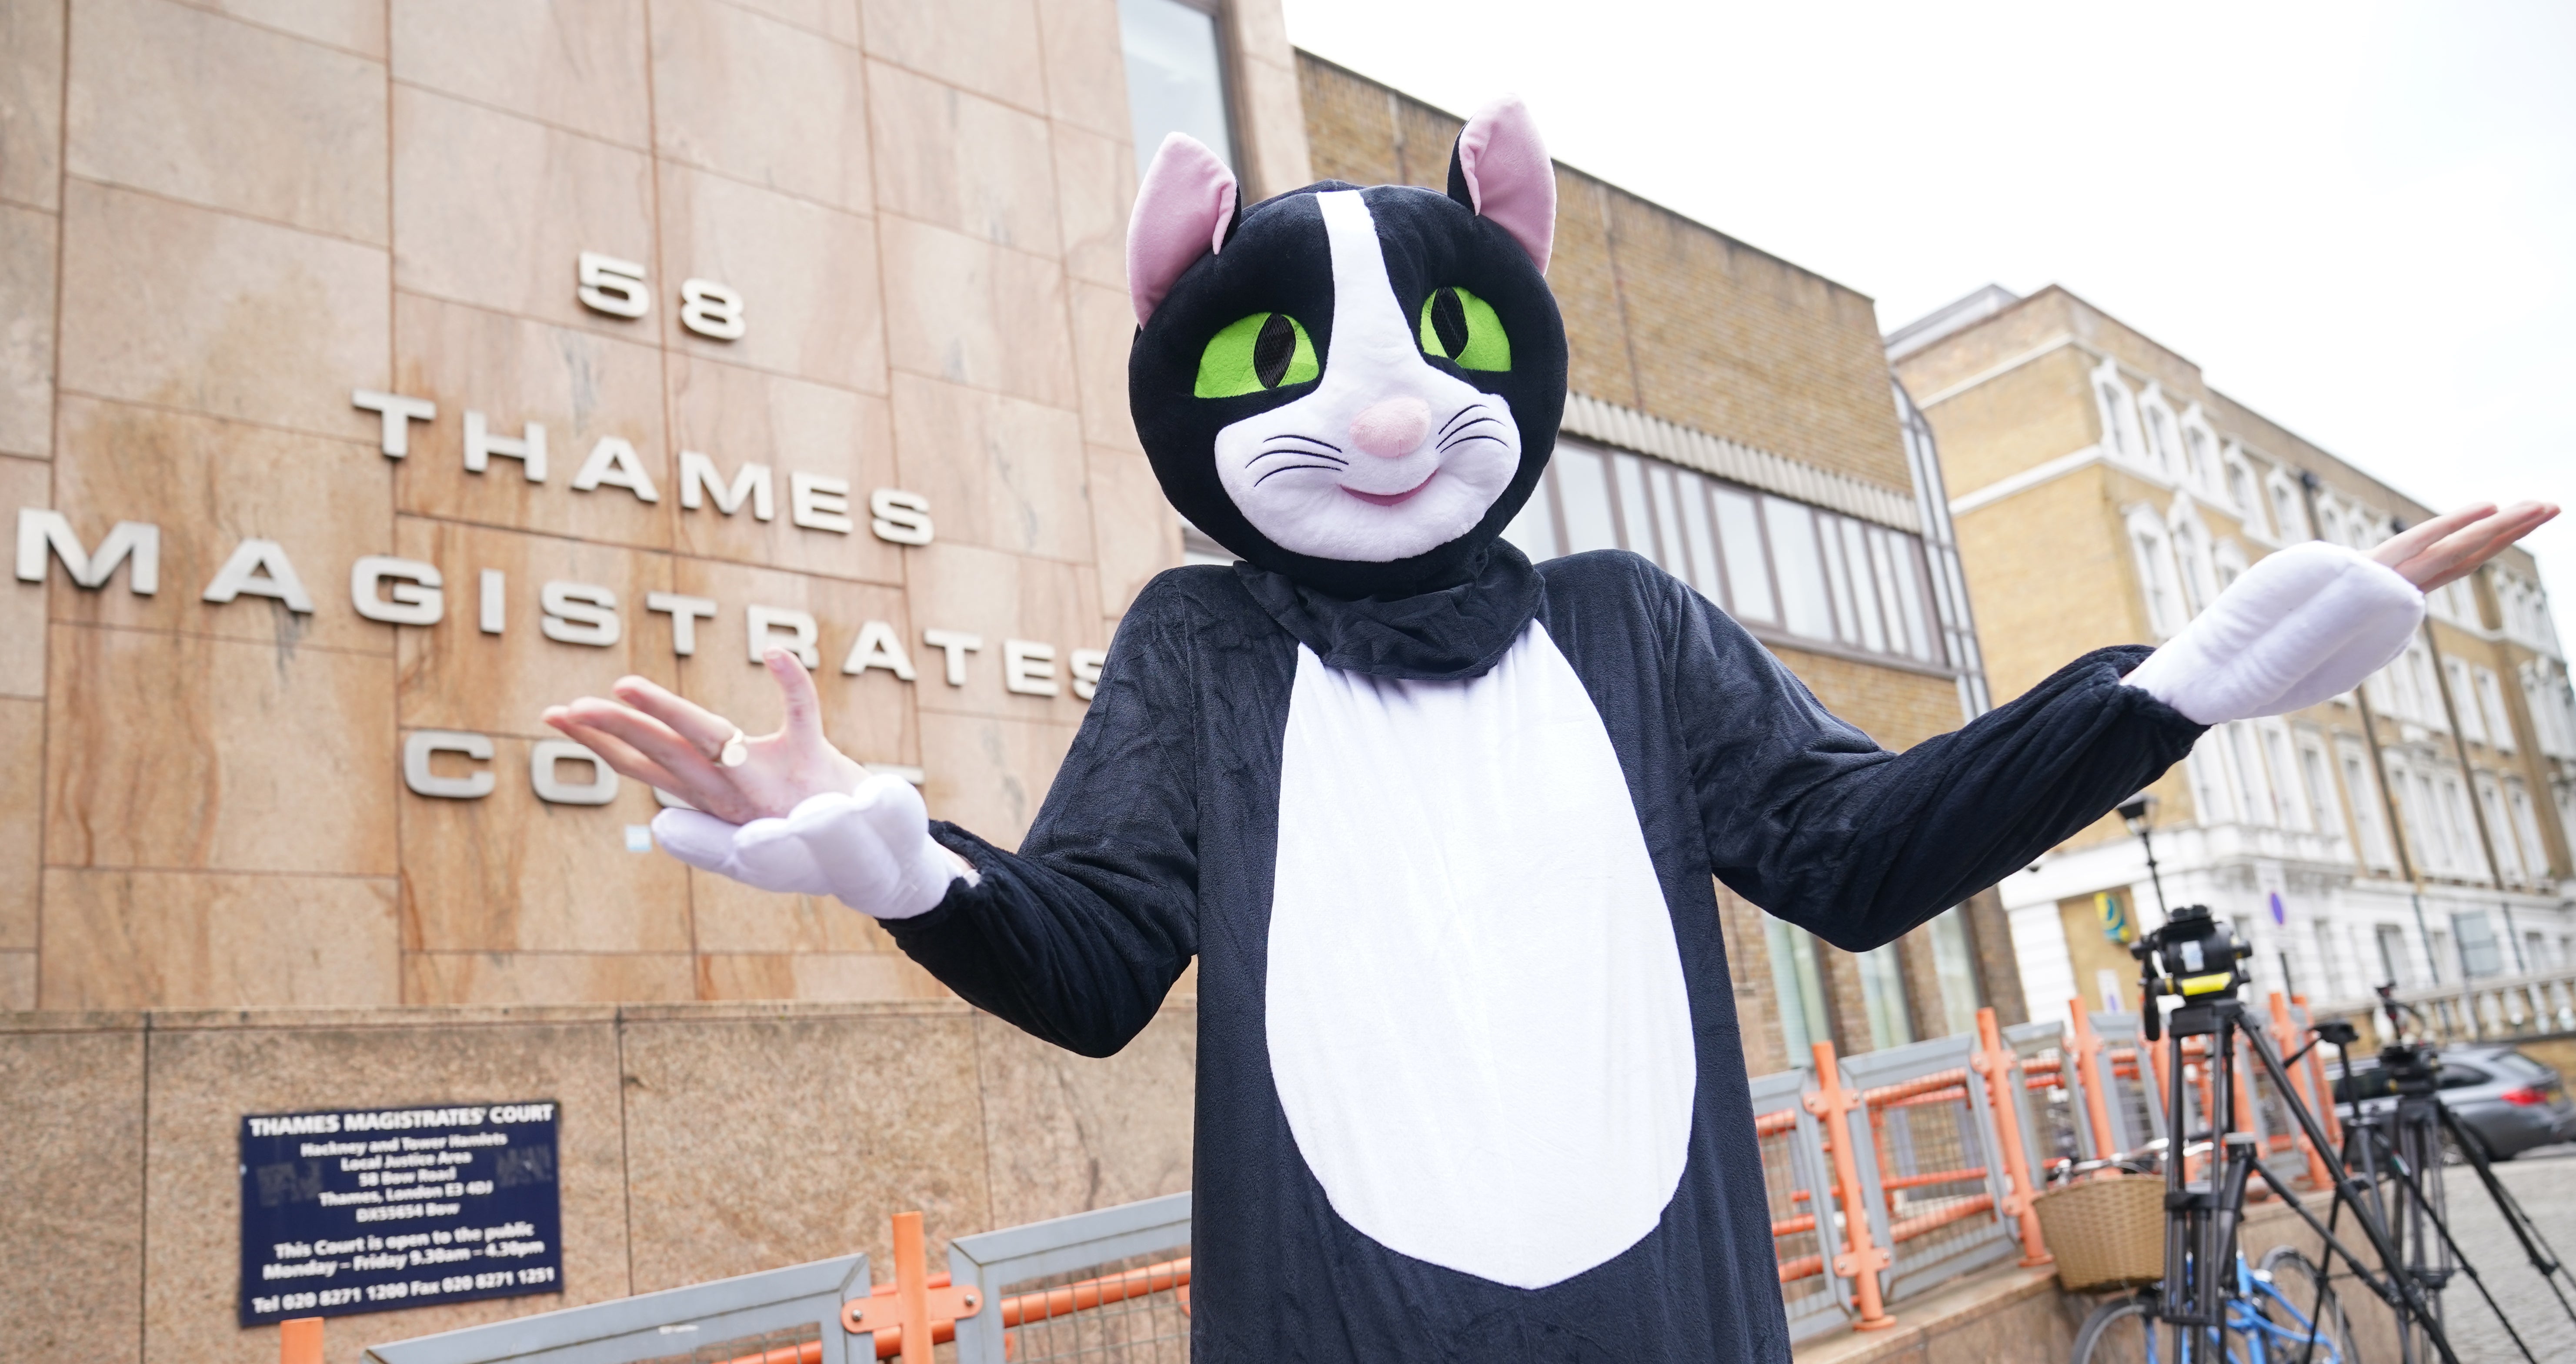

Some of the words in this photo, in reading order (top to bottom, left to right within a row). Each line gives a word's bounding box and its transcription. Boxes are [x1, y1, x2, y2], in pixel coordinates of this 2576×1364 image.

[578, 251, 746, 341] 58
[352, 389, 934, 546] THAMES
[248, 1114, 340, 1137] THAMES
[344, 1107, 487, 1131] MAGISTRATES'
[489, 1104, 554, 1124] COURT
[300, 1140, 368, 1157] Hackney
[368, 1137, 400, 1153] and
[400, 1137, 447, 1151] Tower
[448, 1132, 508, 1148] Hamlets
[340, 1154, 383, 1171] Local
[384, 1152, 436, 1169] Justice
[437, 1151, 473, 1165] Area
[358, 1172, 380, 1187] 58
[380, 1171, 416, 1185] Bow
[417, 1166, 457, 1183] Road
[318, 1191, 384, 1207] Thames,
[385, 1184, 444, 1201] London
[444, 1182, 465, 1197] E3
[466, 1180, 494, 1195] 4DJ
[425, 1202, 461, 1217] Bow
[274, 1241, 313, 1260] This
[314, 1237, 366, 1256] Court
[367, 1234, 384, 1250] is
[385, 1233, 430, 1251] open
[431, 1230, 453, 1244] to
[453, 1227, 483, 1243] the
[484, 1221, 535, 1243] public
[262, 1259, 338, 1280] Monday
[353, 1252, 408, 1271] Friday
[409, 1247, 471, 1266] 9.30am
[484, 1240, 545, 1258] 4.30pm
[252, 1294, 280, 1314] Tel
[282, 1291, 317, 1311] 020
[319, 1287, 362, 1306] 8271
[366, 1282, 408, 1301] 1200
[410, 1280, 440, 1296] Fax
[442, 1275, 474, 1293] 020
[475, 1270, 514, 1289] 8271
[517, 1266, 555, 1284] 1251
